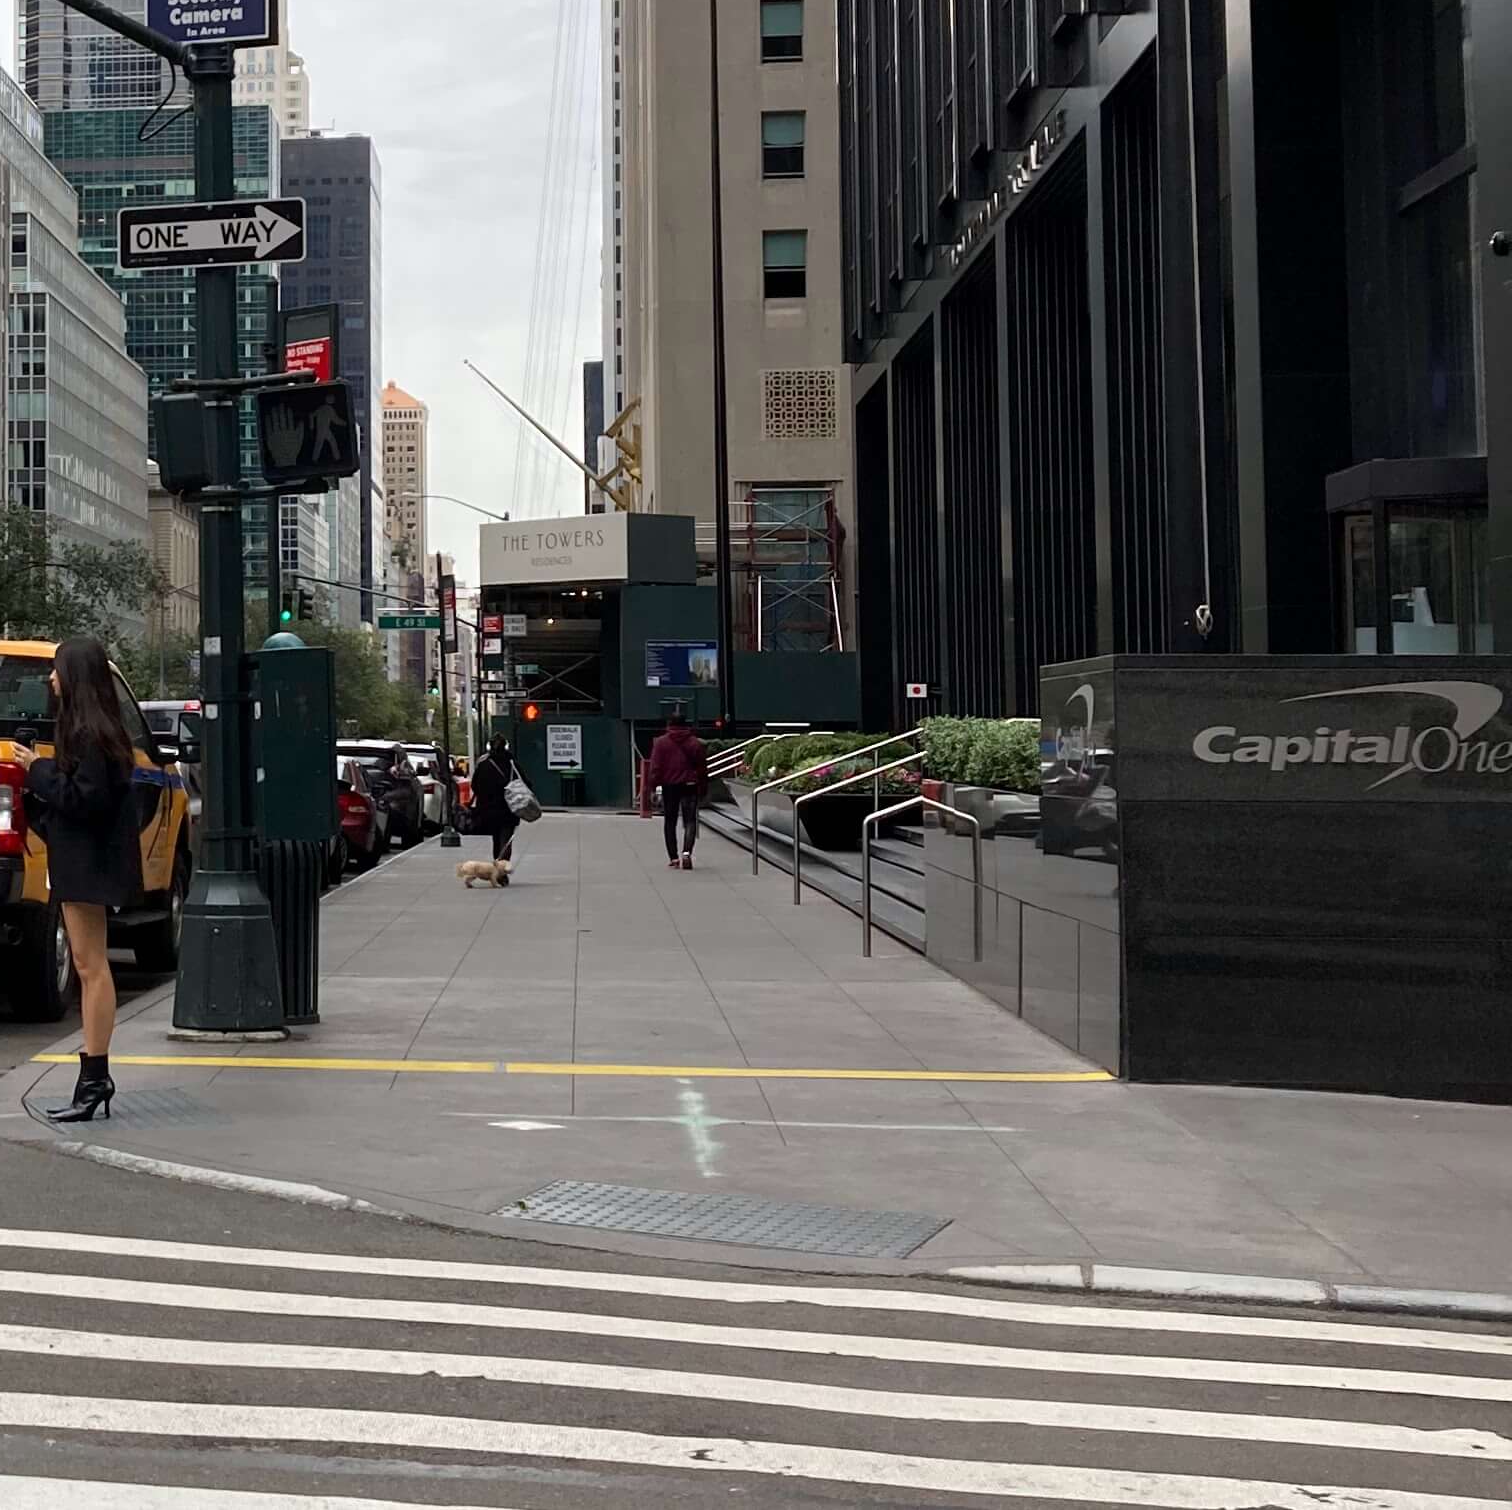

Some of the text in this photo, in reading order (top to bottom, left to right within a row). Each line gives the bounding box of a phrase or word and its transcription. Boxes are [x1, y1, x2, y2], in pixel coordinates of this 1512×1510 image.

[169, 7, 243, 25] Camera
[199, 26, 226, 37] Area
[136, 219, 278, 250] ONE WAY
[502, 529, 604, 552] THE TOWERS
